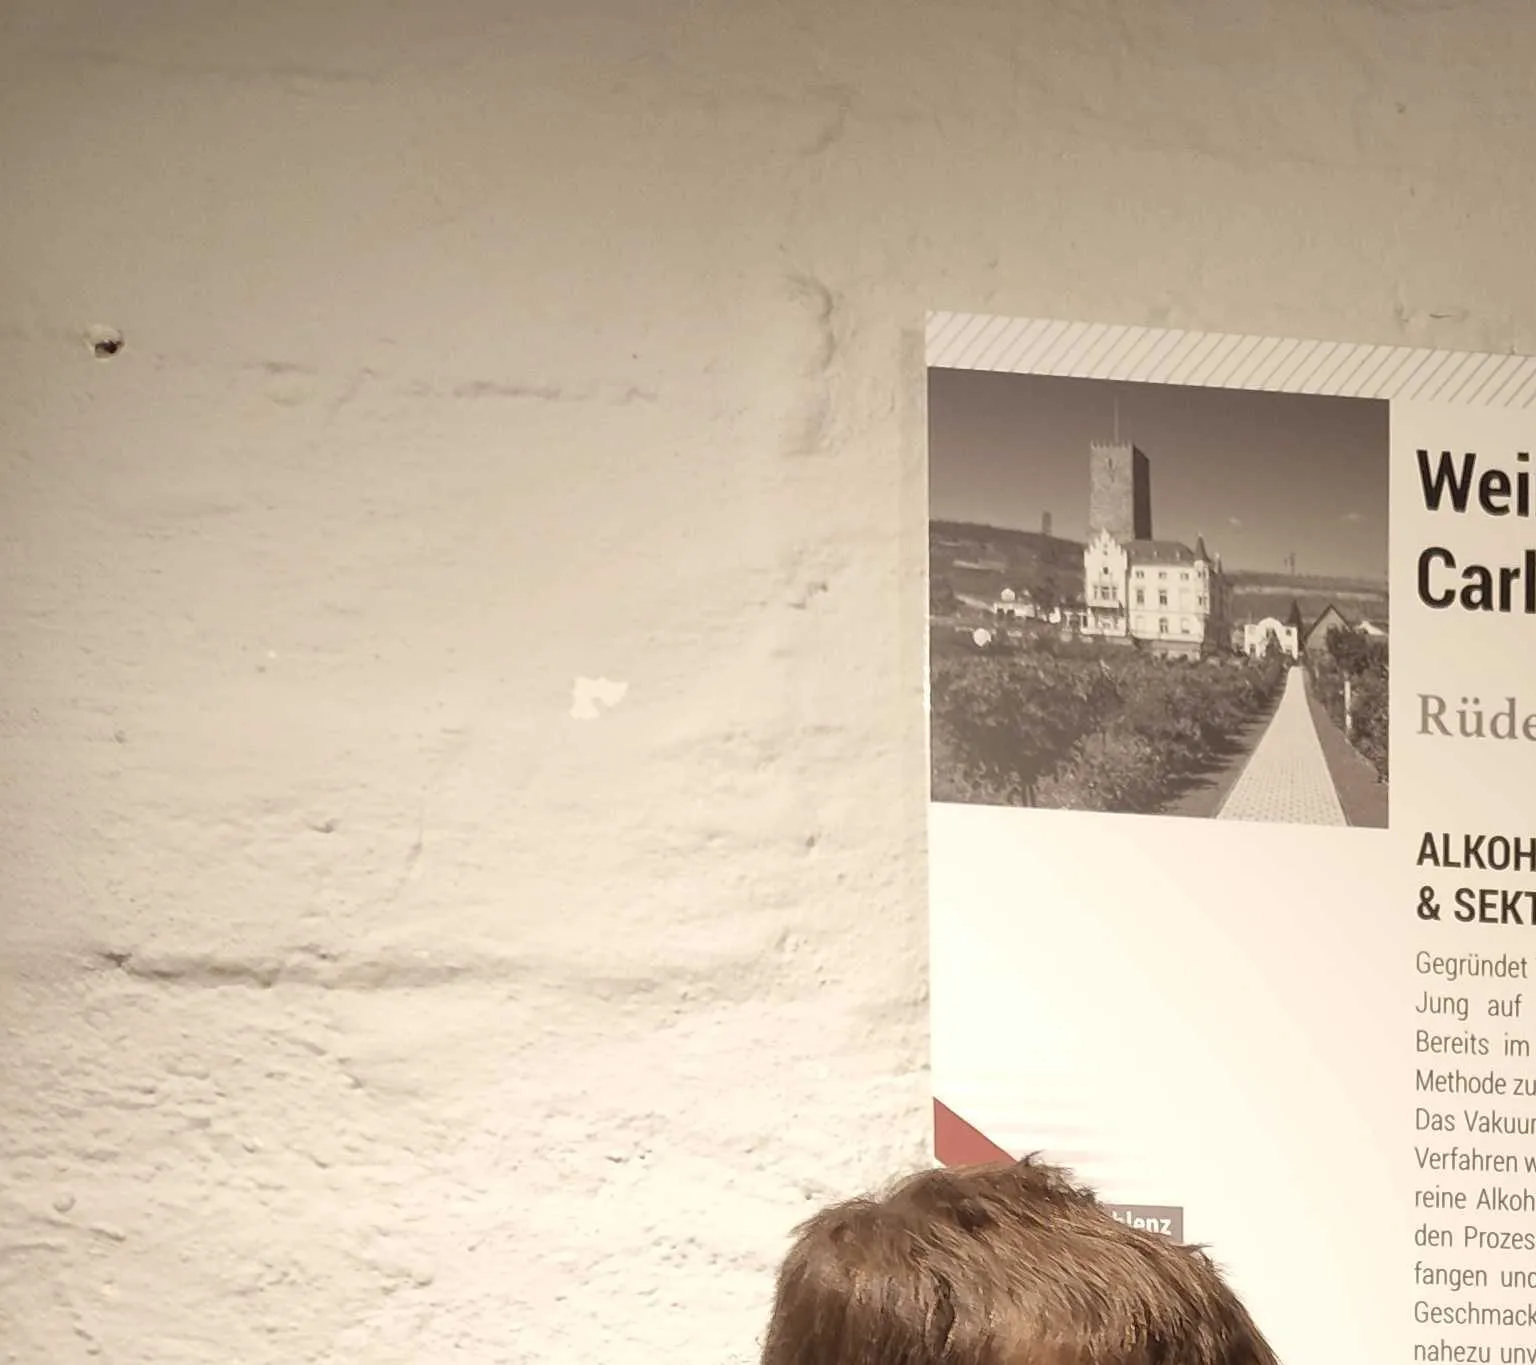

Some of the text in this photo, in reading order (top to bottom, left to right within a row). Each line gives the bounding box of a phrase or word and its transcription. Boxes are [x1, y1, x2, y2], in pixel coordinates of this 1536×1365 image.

[1417, 886, 1441, 921] &
[1415, 950, 1529, 982] Gegründet
[1414, 990, 1469, 1022] Jung
[1487, 992, 1523, 1019] auf
[1415, 1068, 1507, 1096] Methode
[1415, 1107, 1456, 1132] Das
[1413, 1146, 1518, 1174] Verfahren
[1414, 1184, 1468, 1210] reine
[1413, 1260, 1488, 1292] fangen
[1413, 1338, 1491, 1364] nahezu
